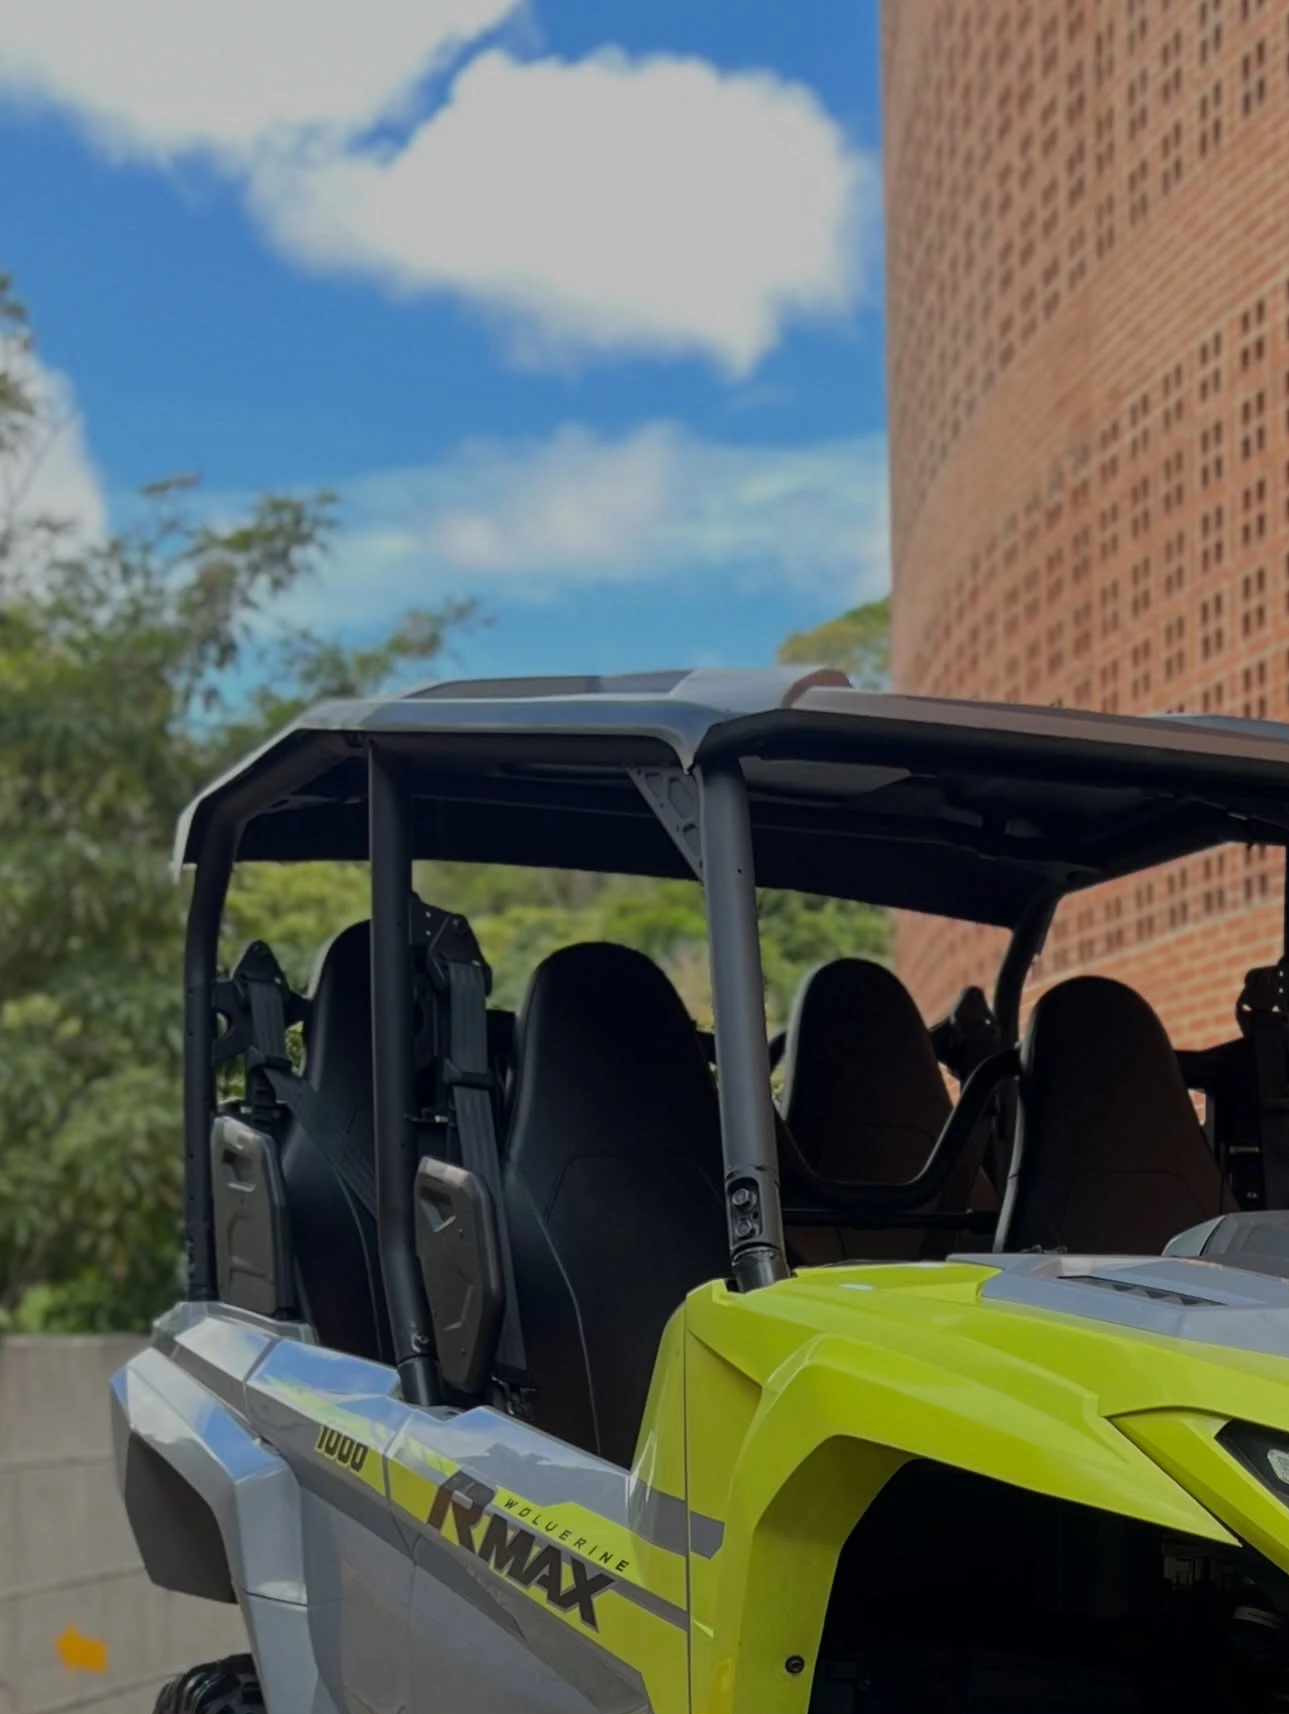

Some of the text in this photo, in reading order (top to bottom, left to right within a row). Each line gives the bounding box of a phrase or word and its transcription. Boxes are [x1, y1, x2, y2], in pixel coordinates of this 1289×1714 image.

[317, 1426, 368, 1472] 1000
[426, 1470, 614, 1633] RMAX
[504, 1498, 630, 1573] WOLVERINE
